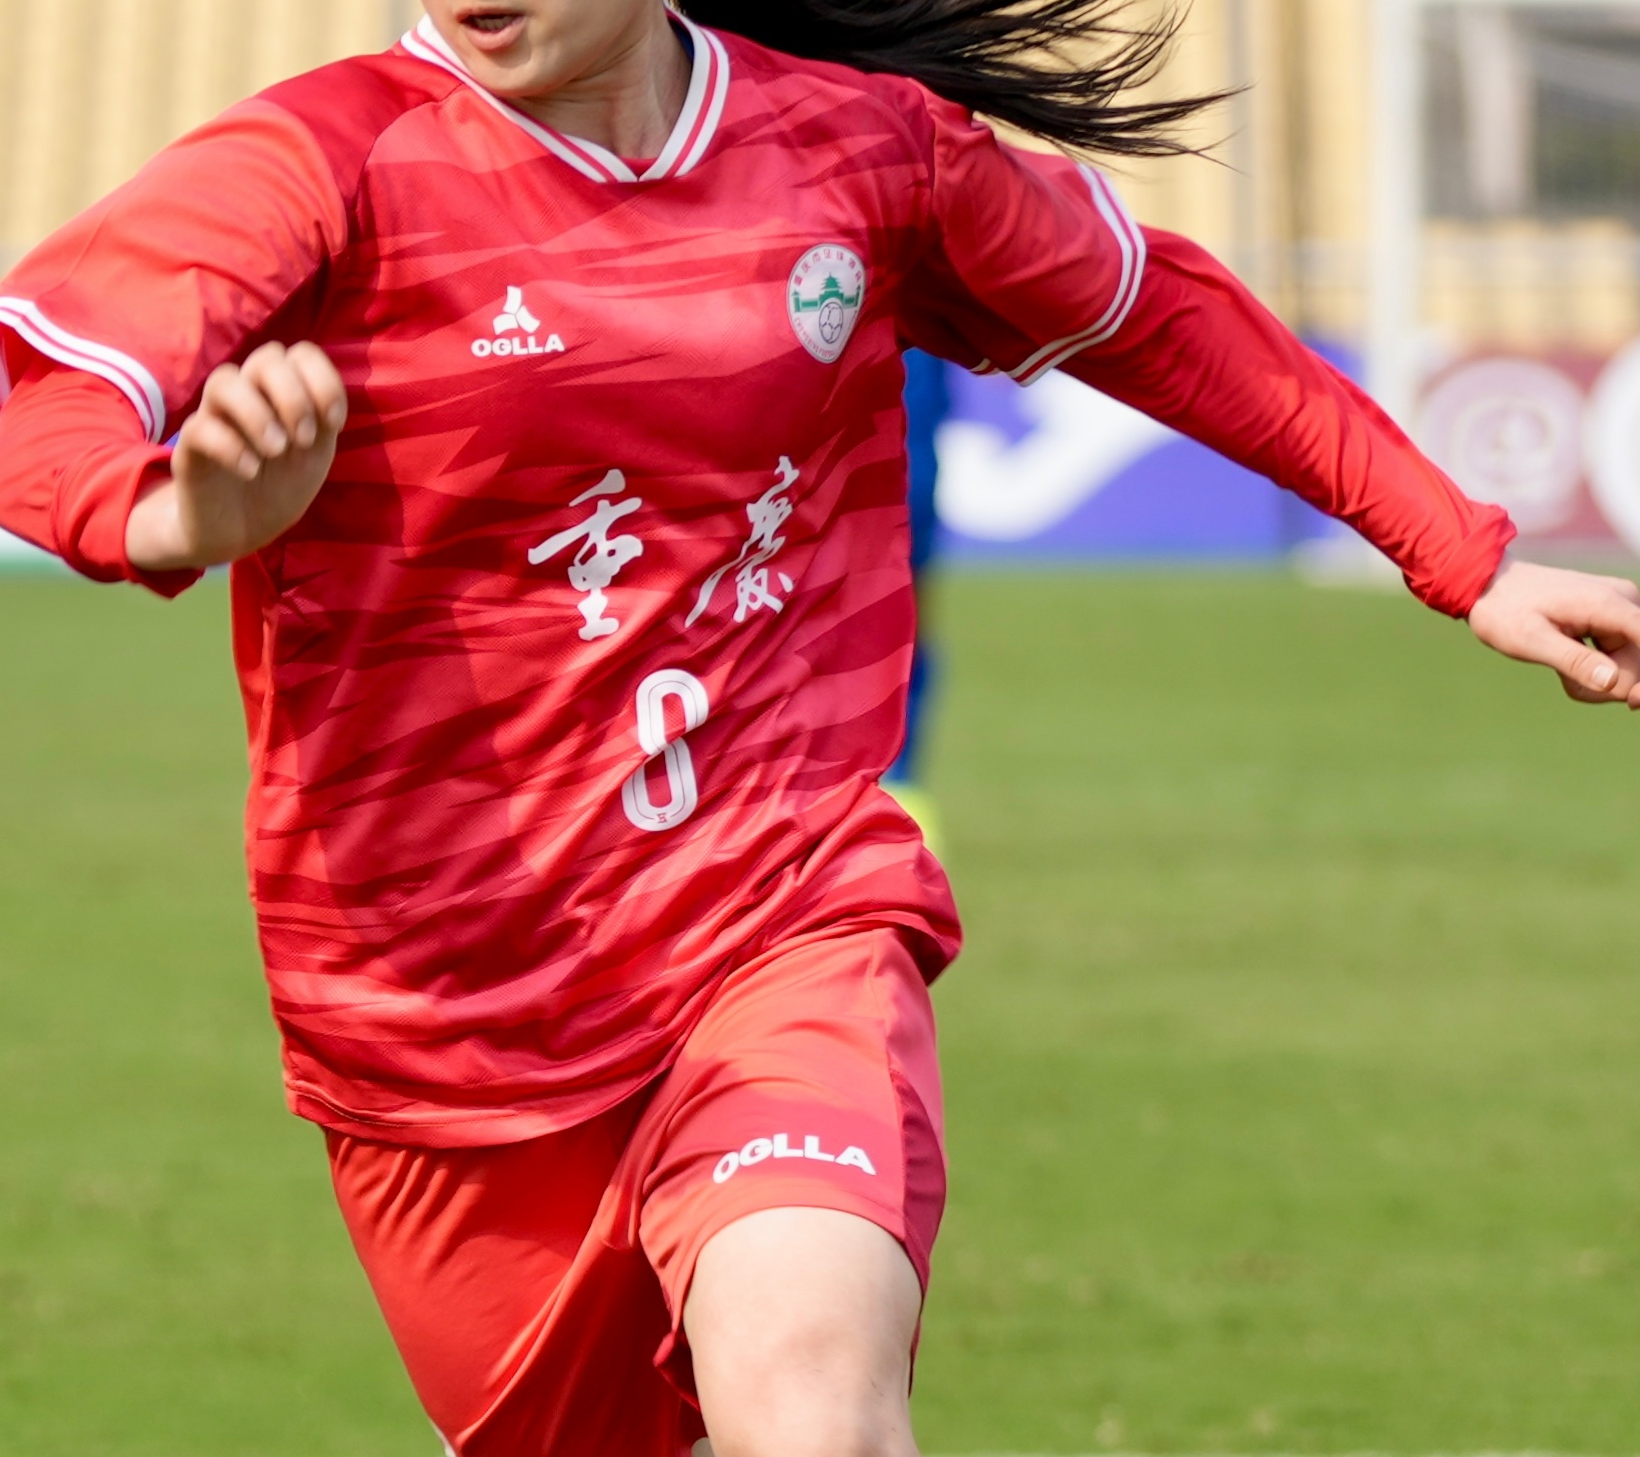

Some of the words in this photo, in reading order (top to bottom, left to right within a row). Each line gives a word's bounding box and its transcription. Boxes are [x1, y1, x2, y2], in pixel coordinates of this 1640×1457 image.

[470, 333, 565, 358] OGLLA
[621, 668, 709, 832] 8
[712, 1132, 877, 1184] OGLLA
